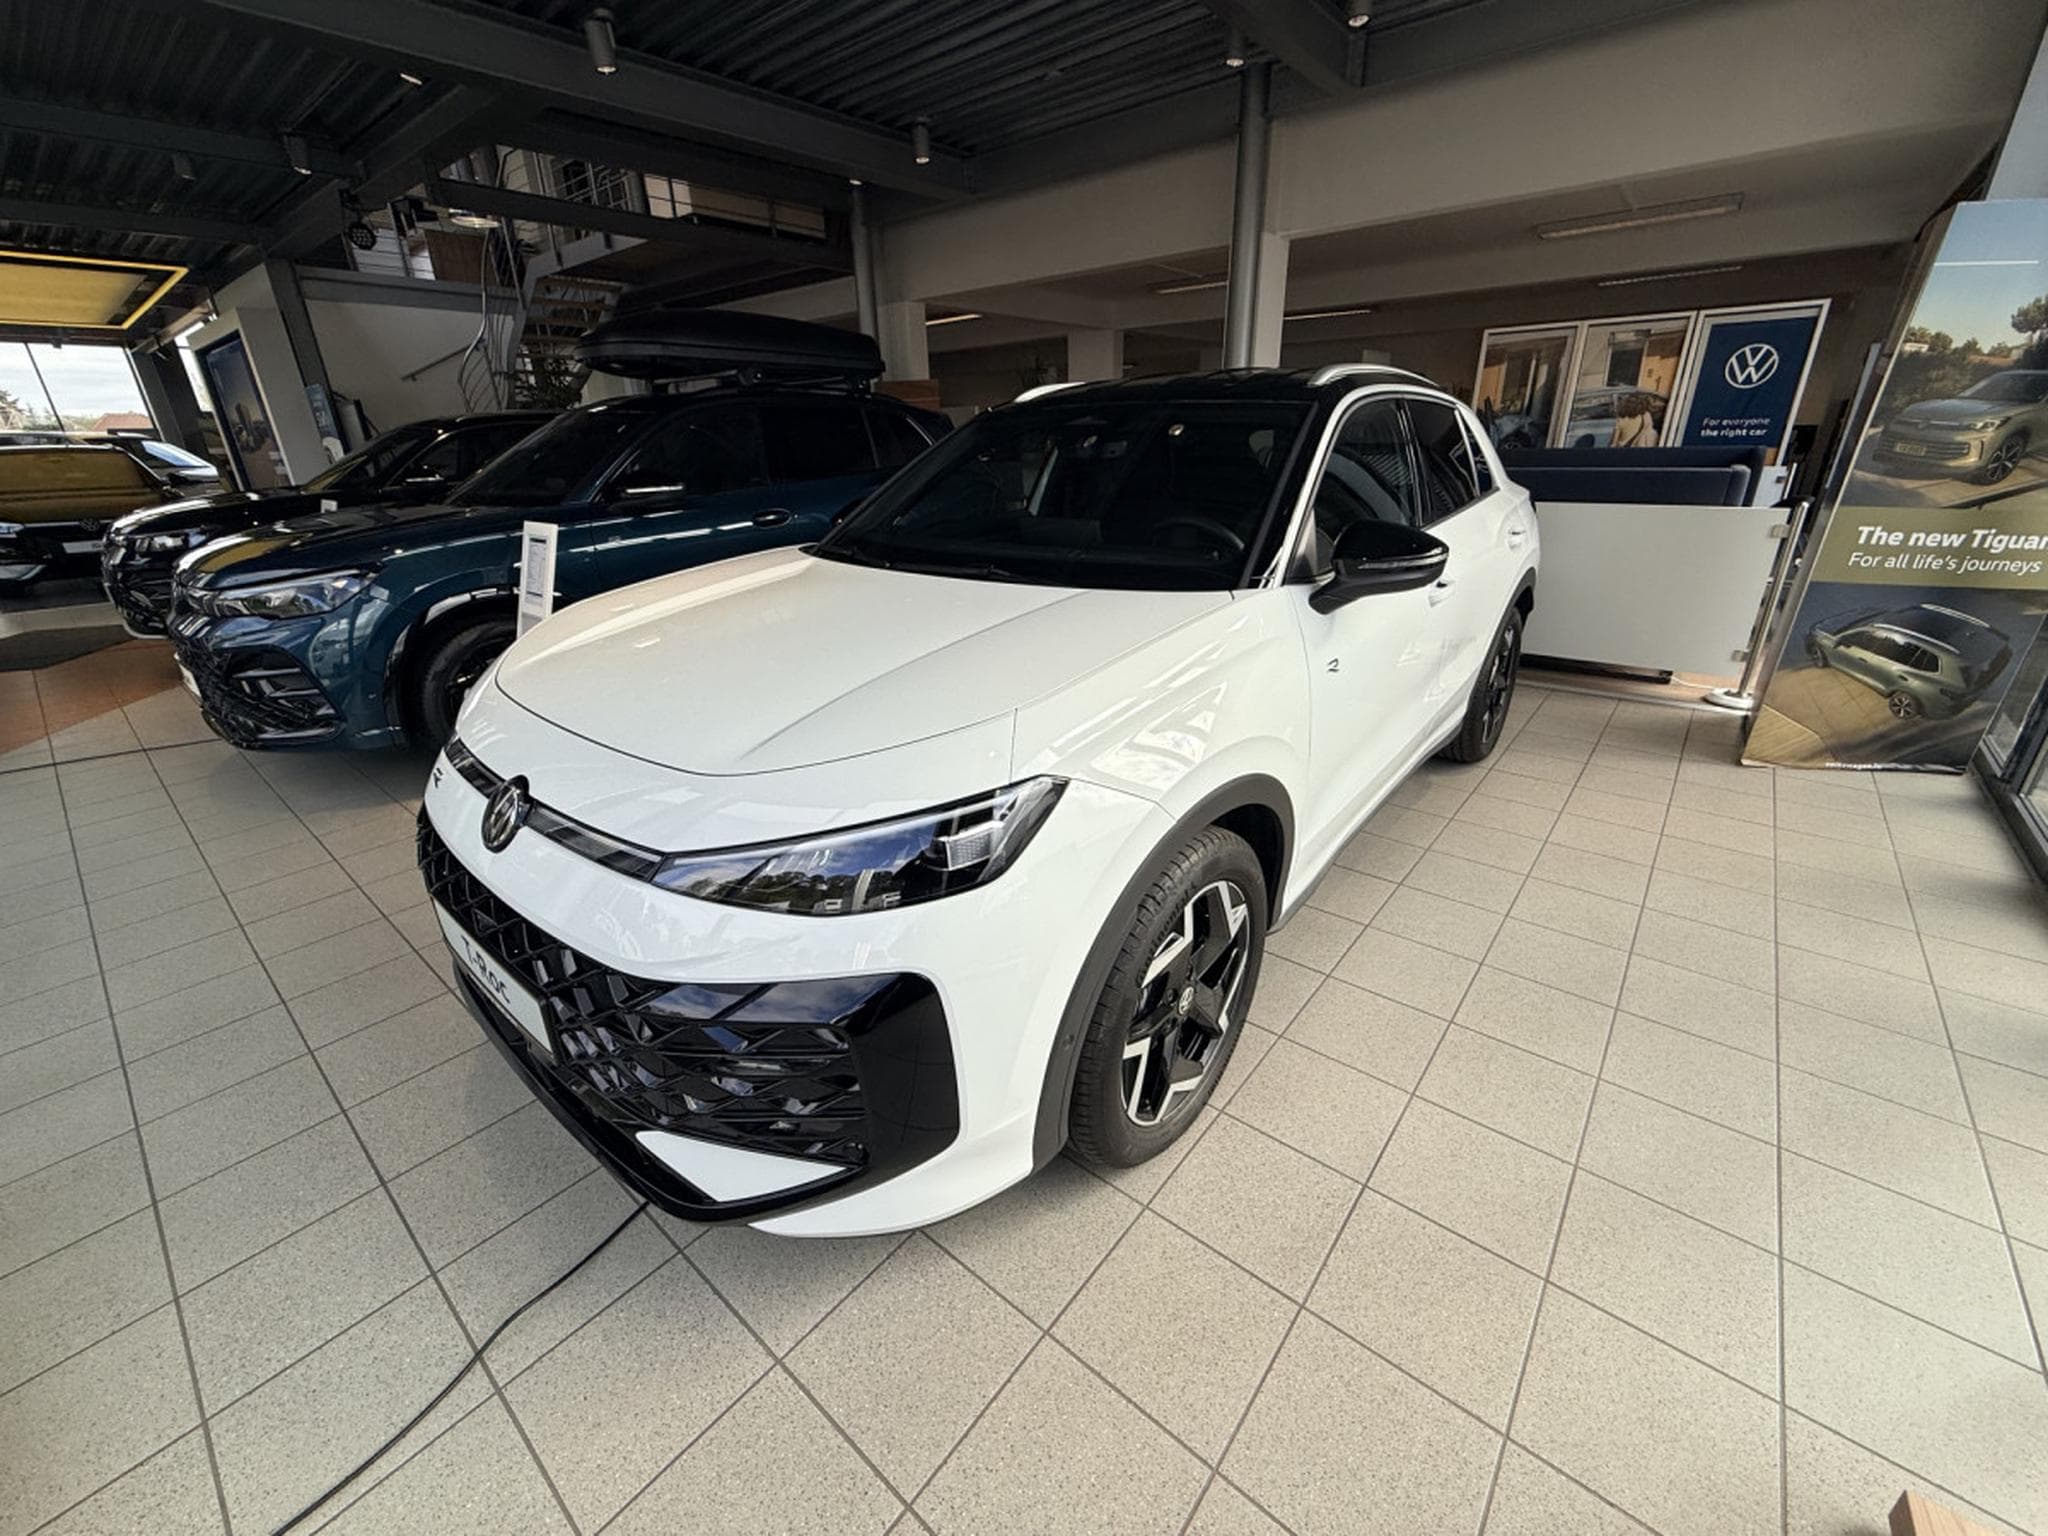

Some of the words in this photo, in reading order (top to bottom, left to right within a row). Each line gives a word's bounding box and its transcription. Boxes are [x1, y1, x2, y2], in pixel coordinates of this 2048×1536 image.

[1702, 417, 1720, 426] For
[1722, 417, 1770, 427] everyone
[1700, 429, 1718, 437] the
[1720, 428, 1747, 438] right
[1858, 526, 1904, 545] The
[1907, 532, 1967, 548] new
[1848, 552, 1882, 567] For
[1884, 553, 1910, 568] all
[1912, 554, 1958, 570] life's
[1957, 556, 2043, 576] journeys
